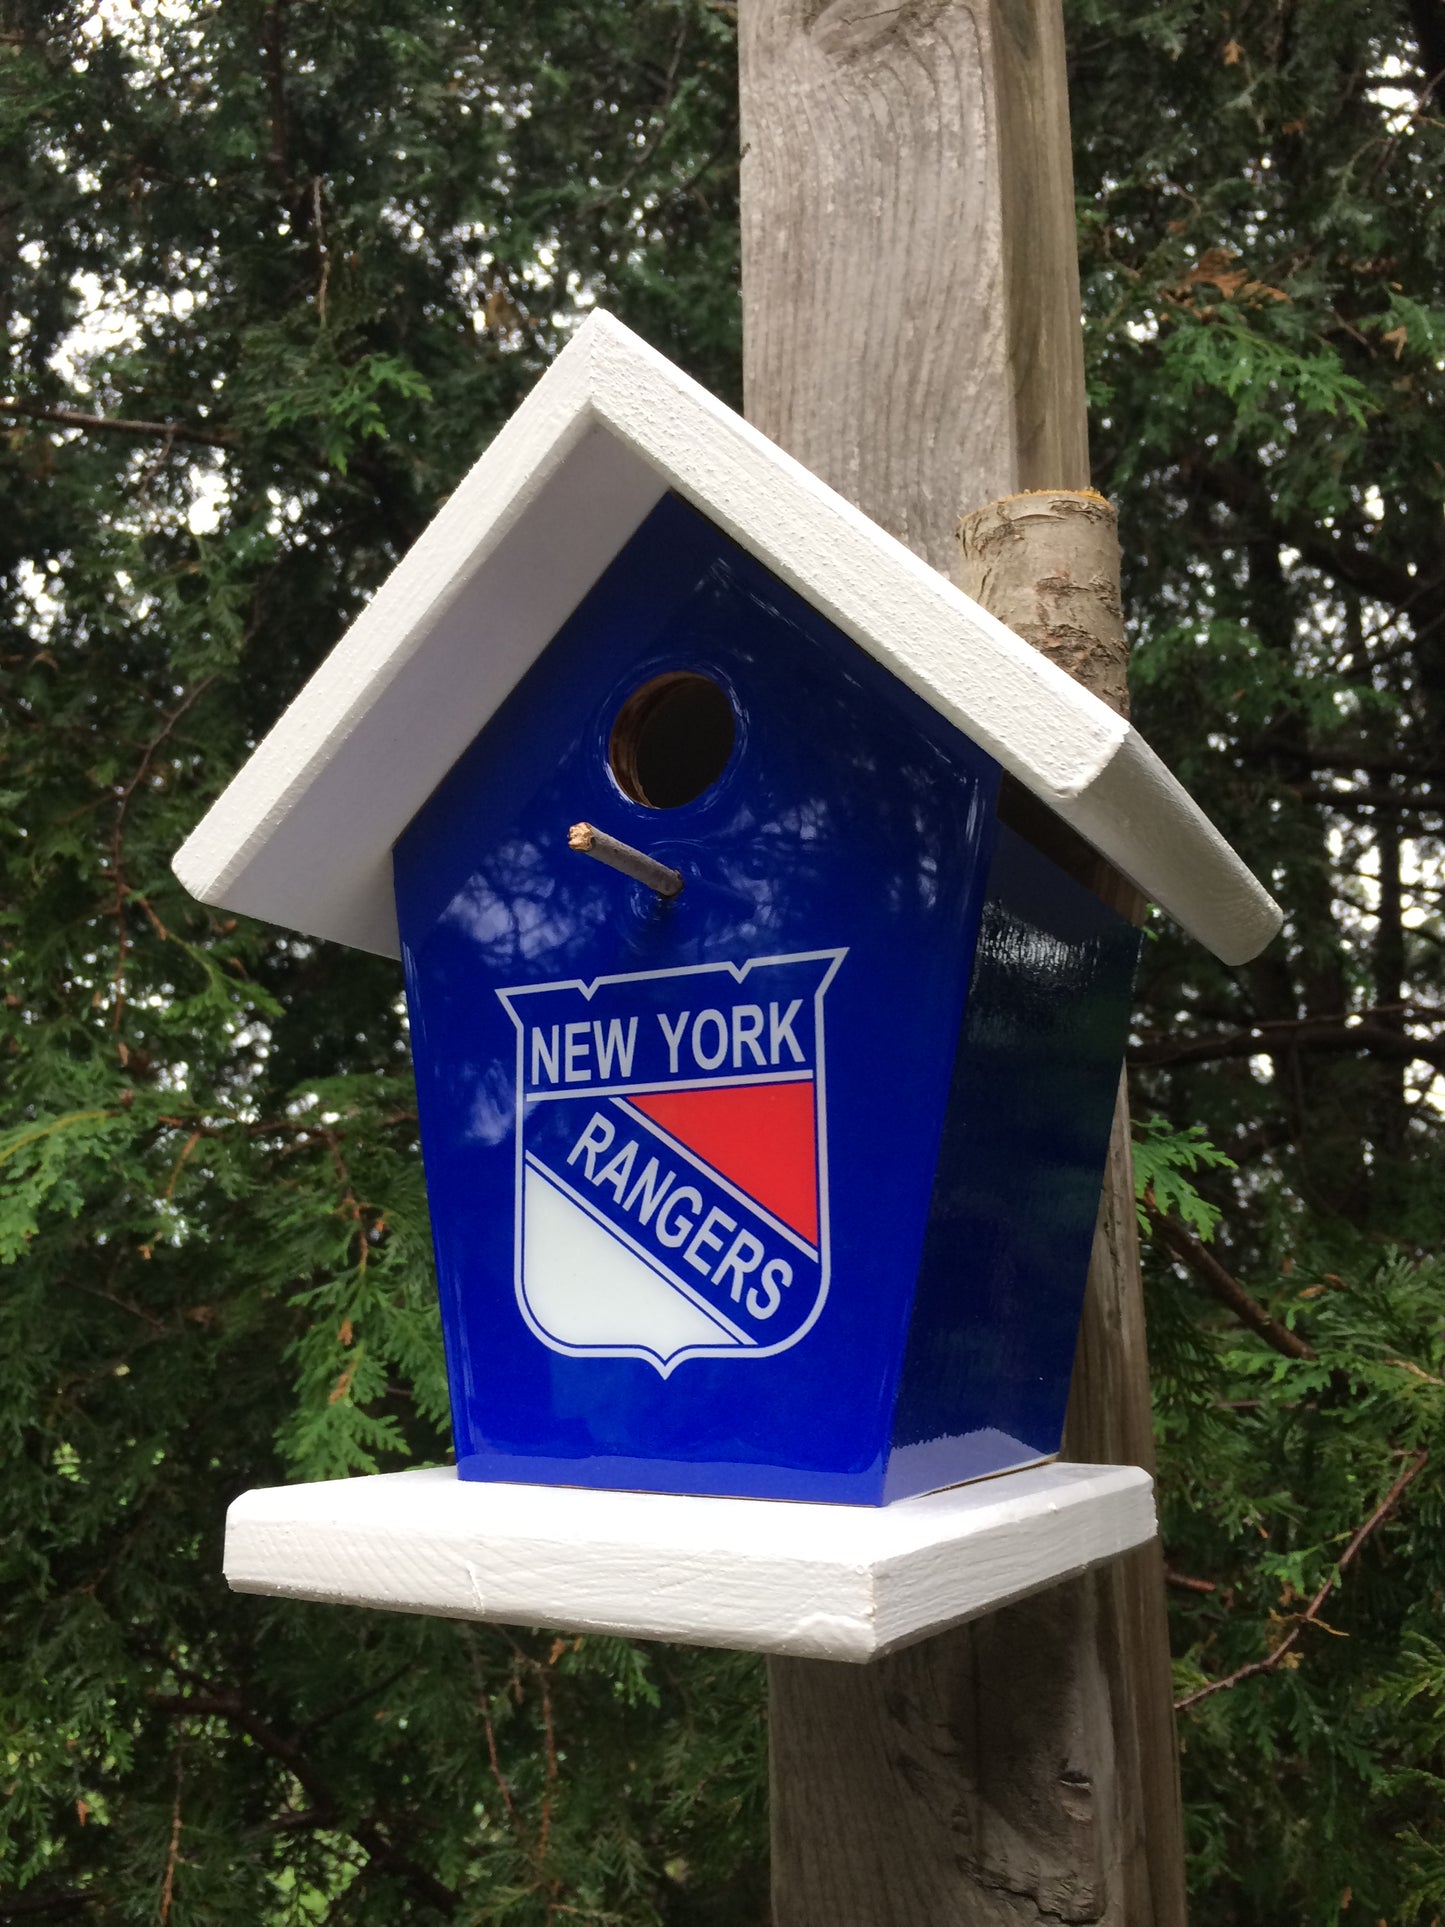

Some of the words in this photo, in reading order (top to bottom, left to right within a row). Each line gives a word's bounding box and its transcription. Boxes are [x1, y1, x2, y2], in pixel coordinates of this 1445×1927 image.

[532, 1017, 638, 1085] NEW
[657, 999, 805, 1073] YORK
[566, 1112, 793, 1320] RANGERS
